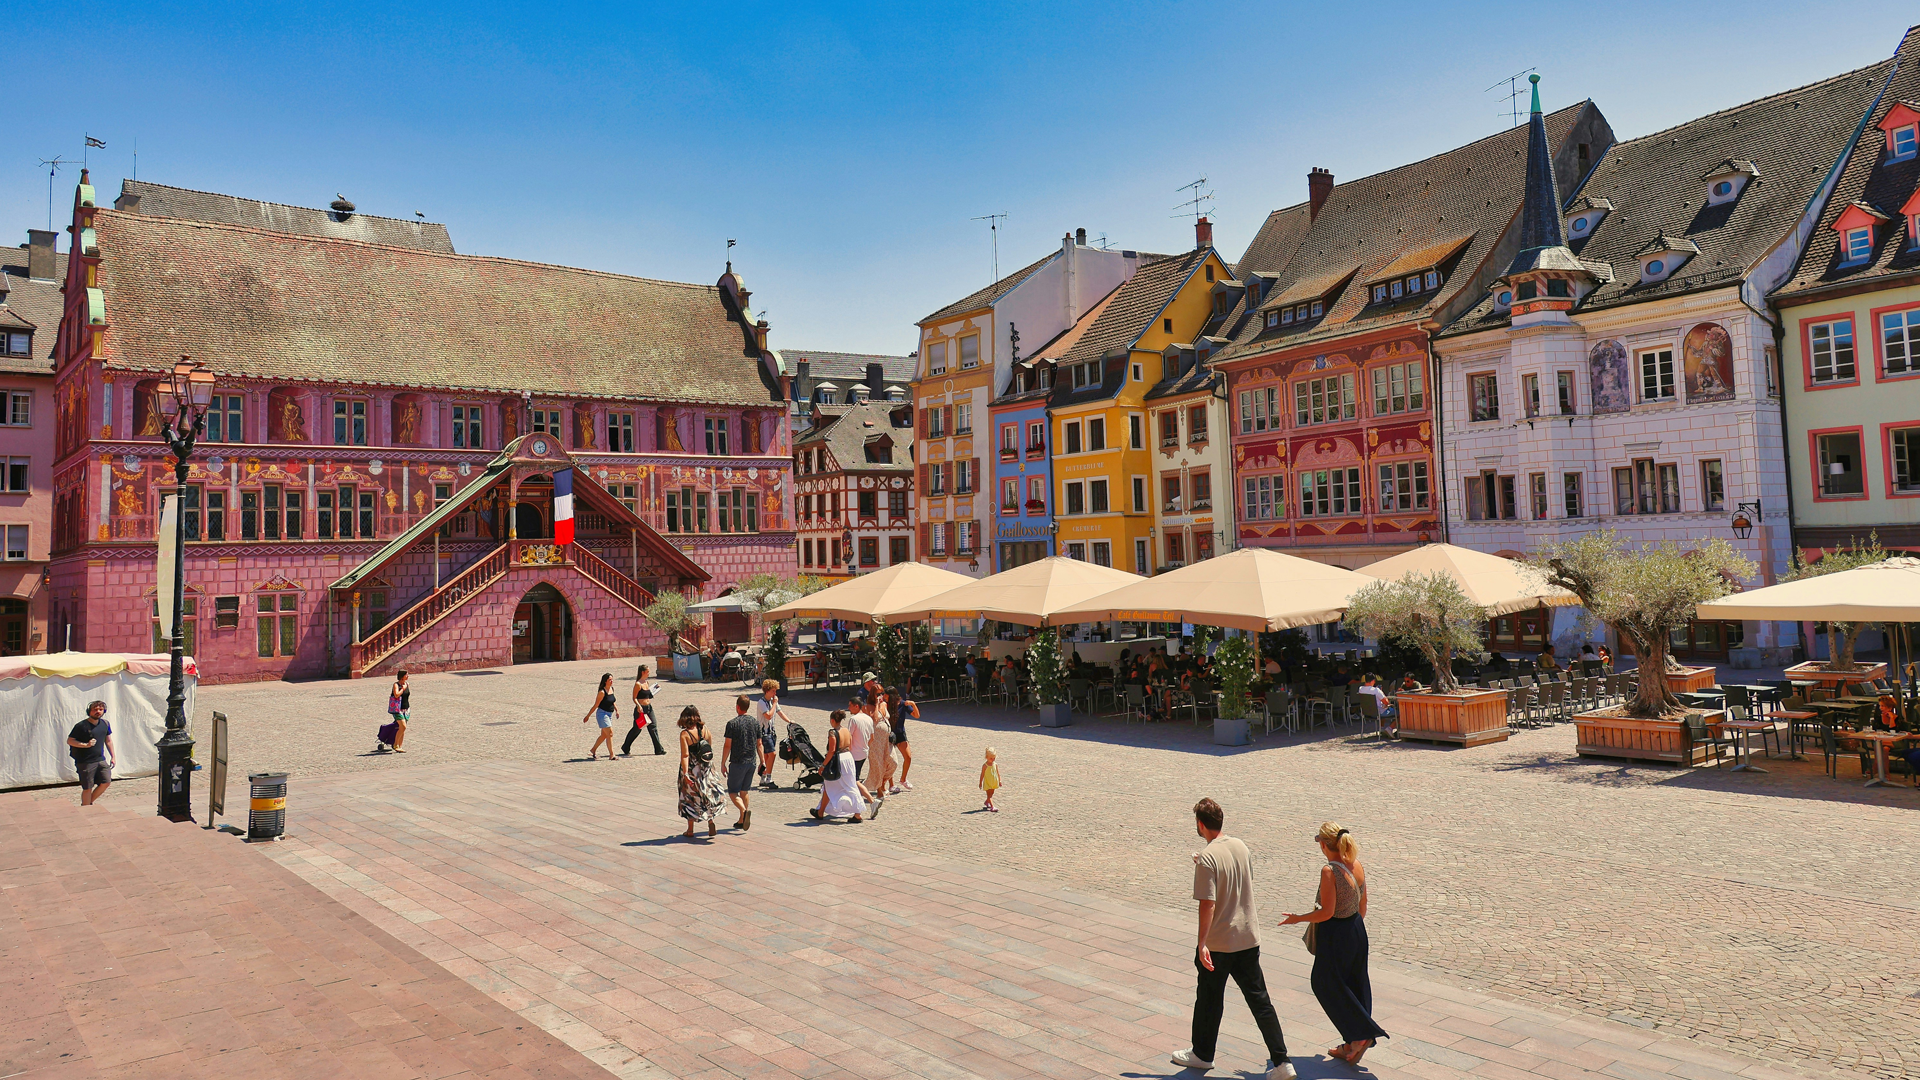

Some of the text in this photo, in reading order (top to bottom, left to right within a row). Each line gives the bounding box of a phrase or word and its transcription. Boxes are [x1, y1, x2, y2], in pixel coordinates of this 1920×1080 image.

[995, 521, 1053, 538] Guillosson
[1132, 610, 1160, 619] Guillaume
[1162, 610, 1174, 620] Tell
